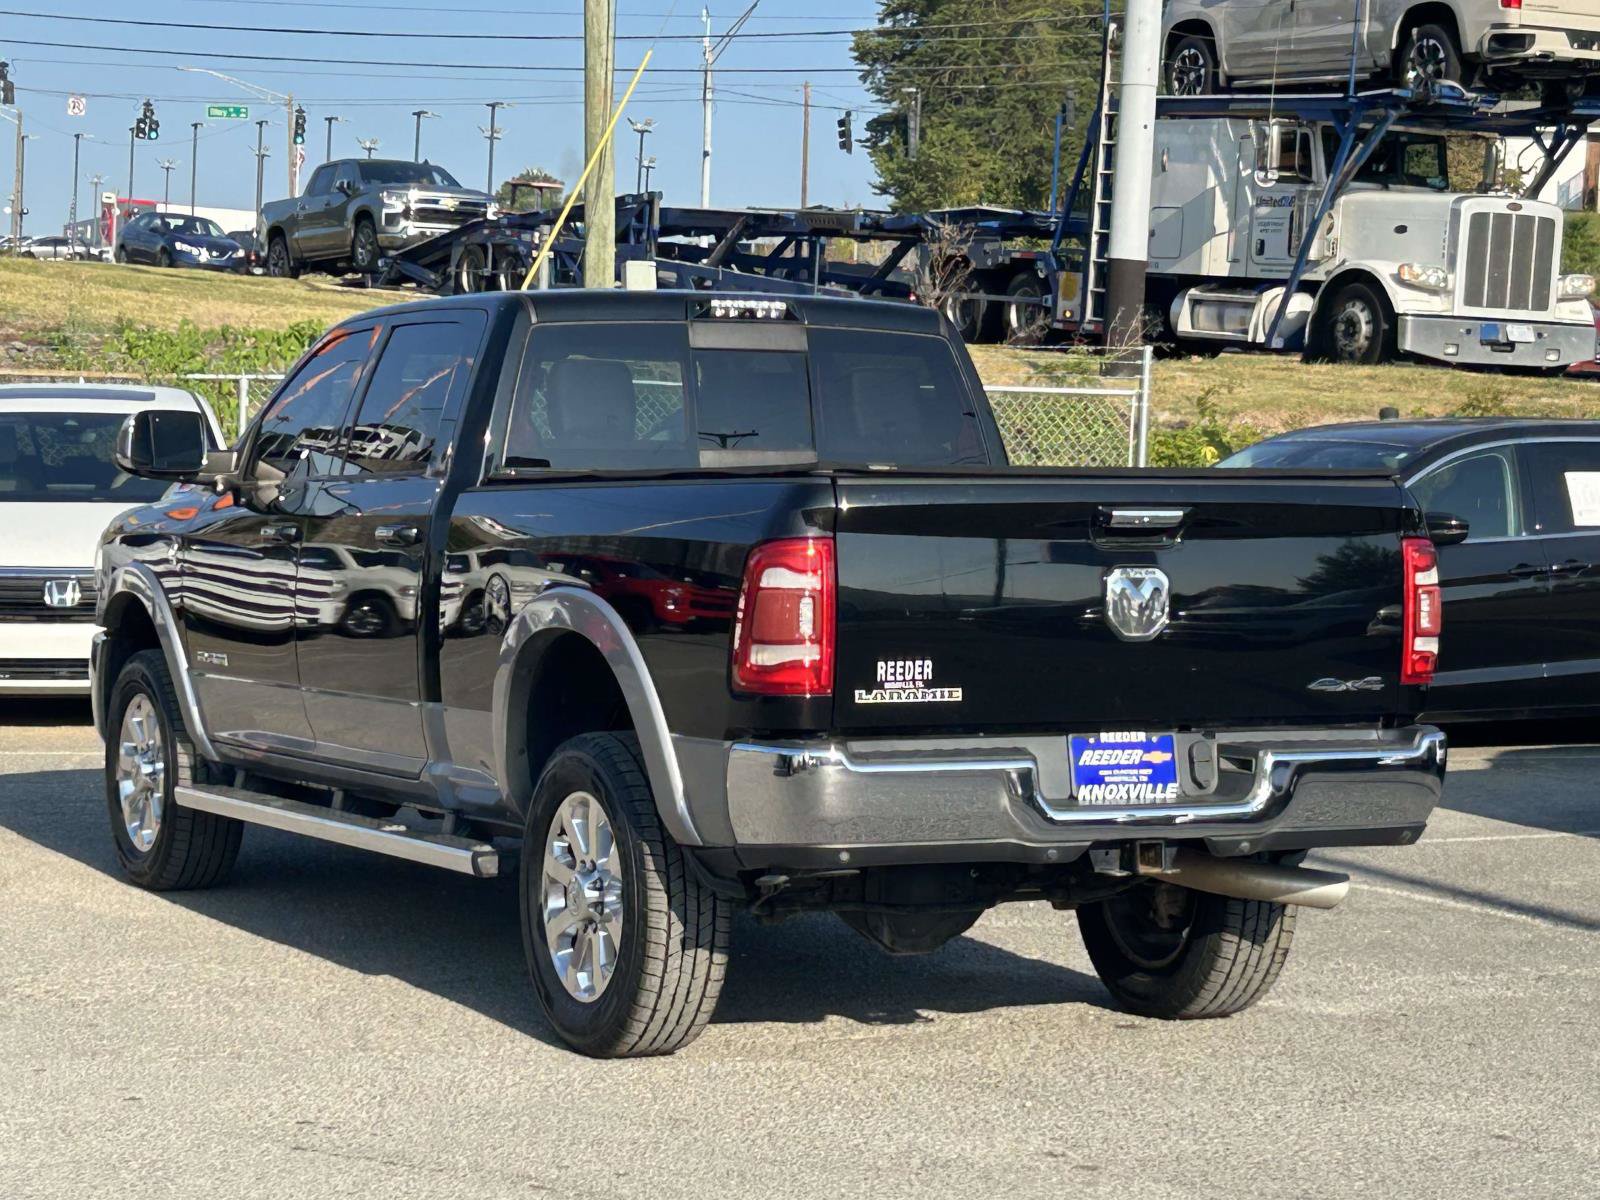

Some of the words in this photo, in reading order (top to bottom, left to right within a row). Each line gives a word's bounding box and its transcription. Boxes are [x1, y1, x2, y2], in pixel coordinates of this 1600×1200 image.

[877, 660, 933, 681] REEDER
[855, 688, 962, 702] LARAMIE
[1078, 749, 1144, 766] REEDER
[1077, 782, 1179, 801] KNOXVILLE
